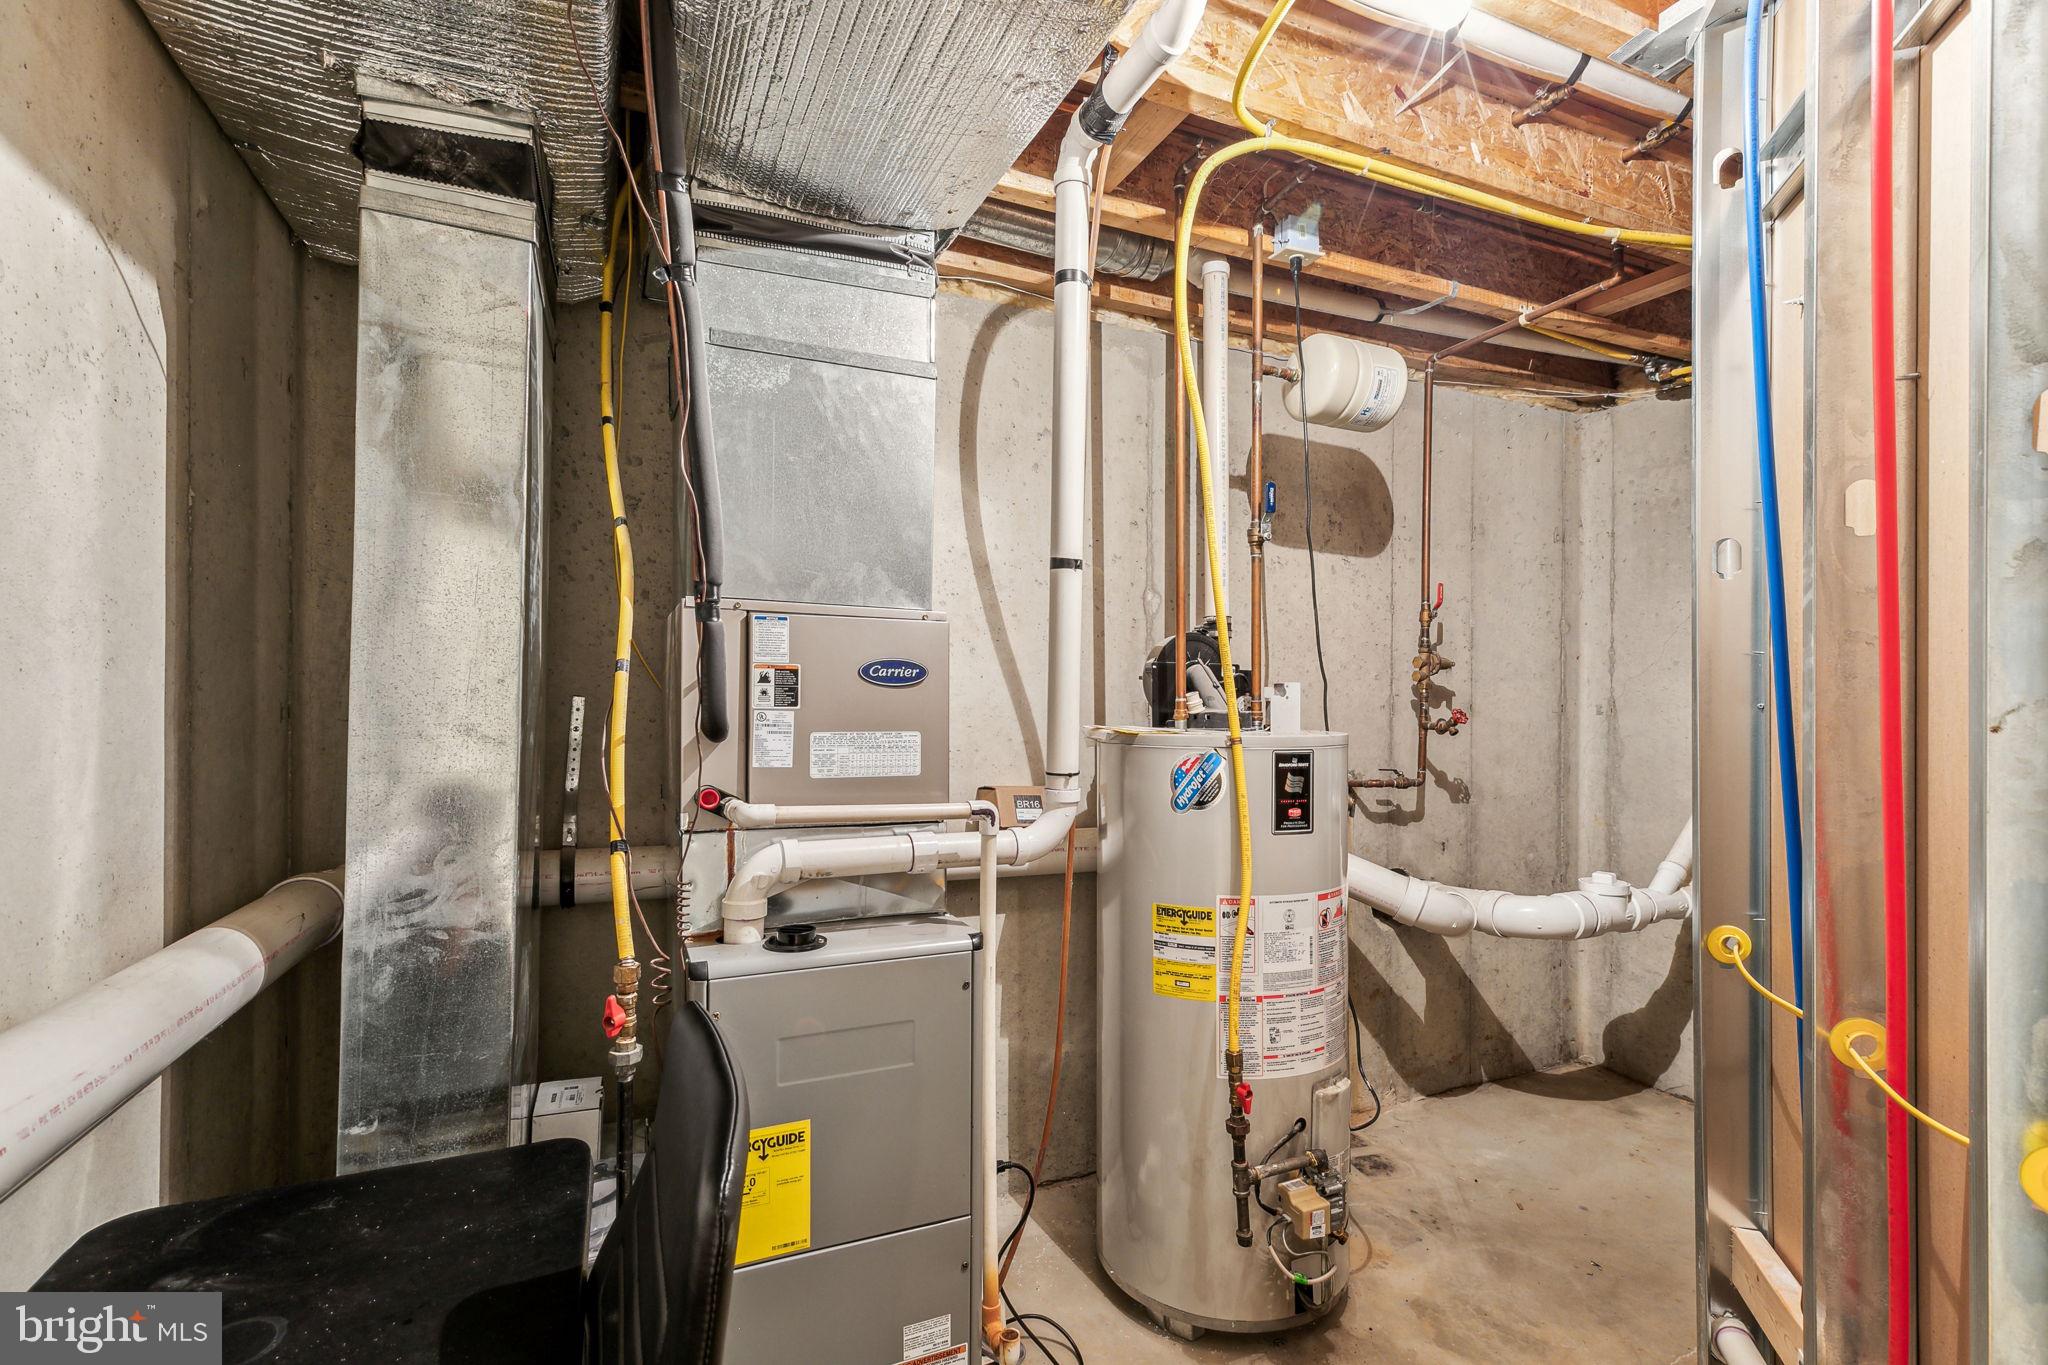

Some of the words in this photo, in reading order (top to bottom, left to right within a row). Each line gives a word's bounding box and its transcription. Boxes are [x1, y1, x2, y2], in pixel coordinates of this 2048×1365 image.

[869, 665, 920, 678] Carrier
[1016, 800, 1041, 809] BR16
[1156, 906, 1213, 921] ENERGYGUIDE
